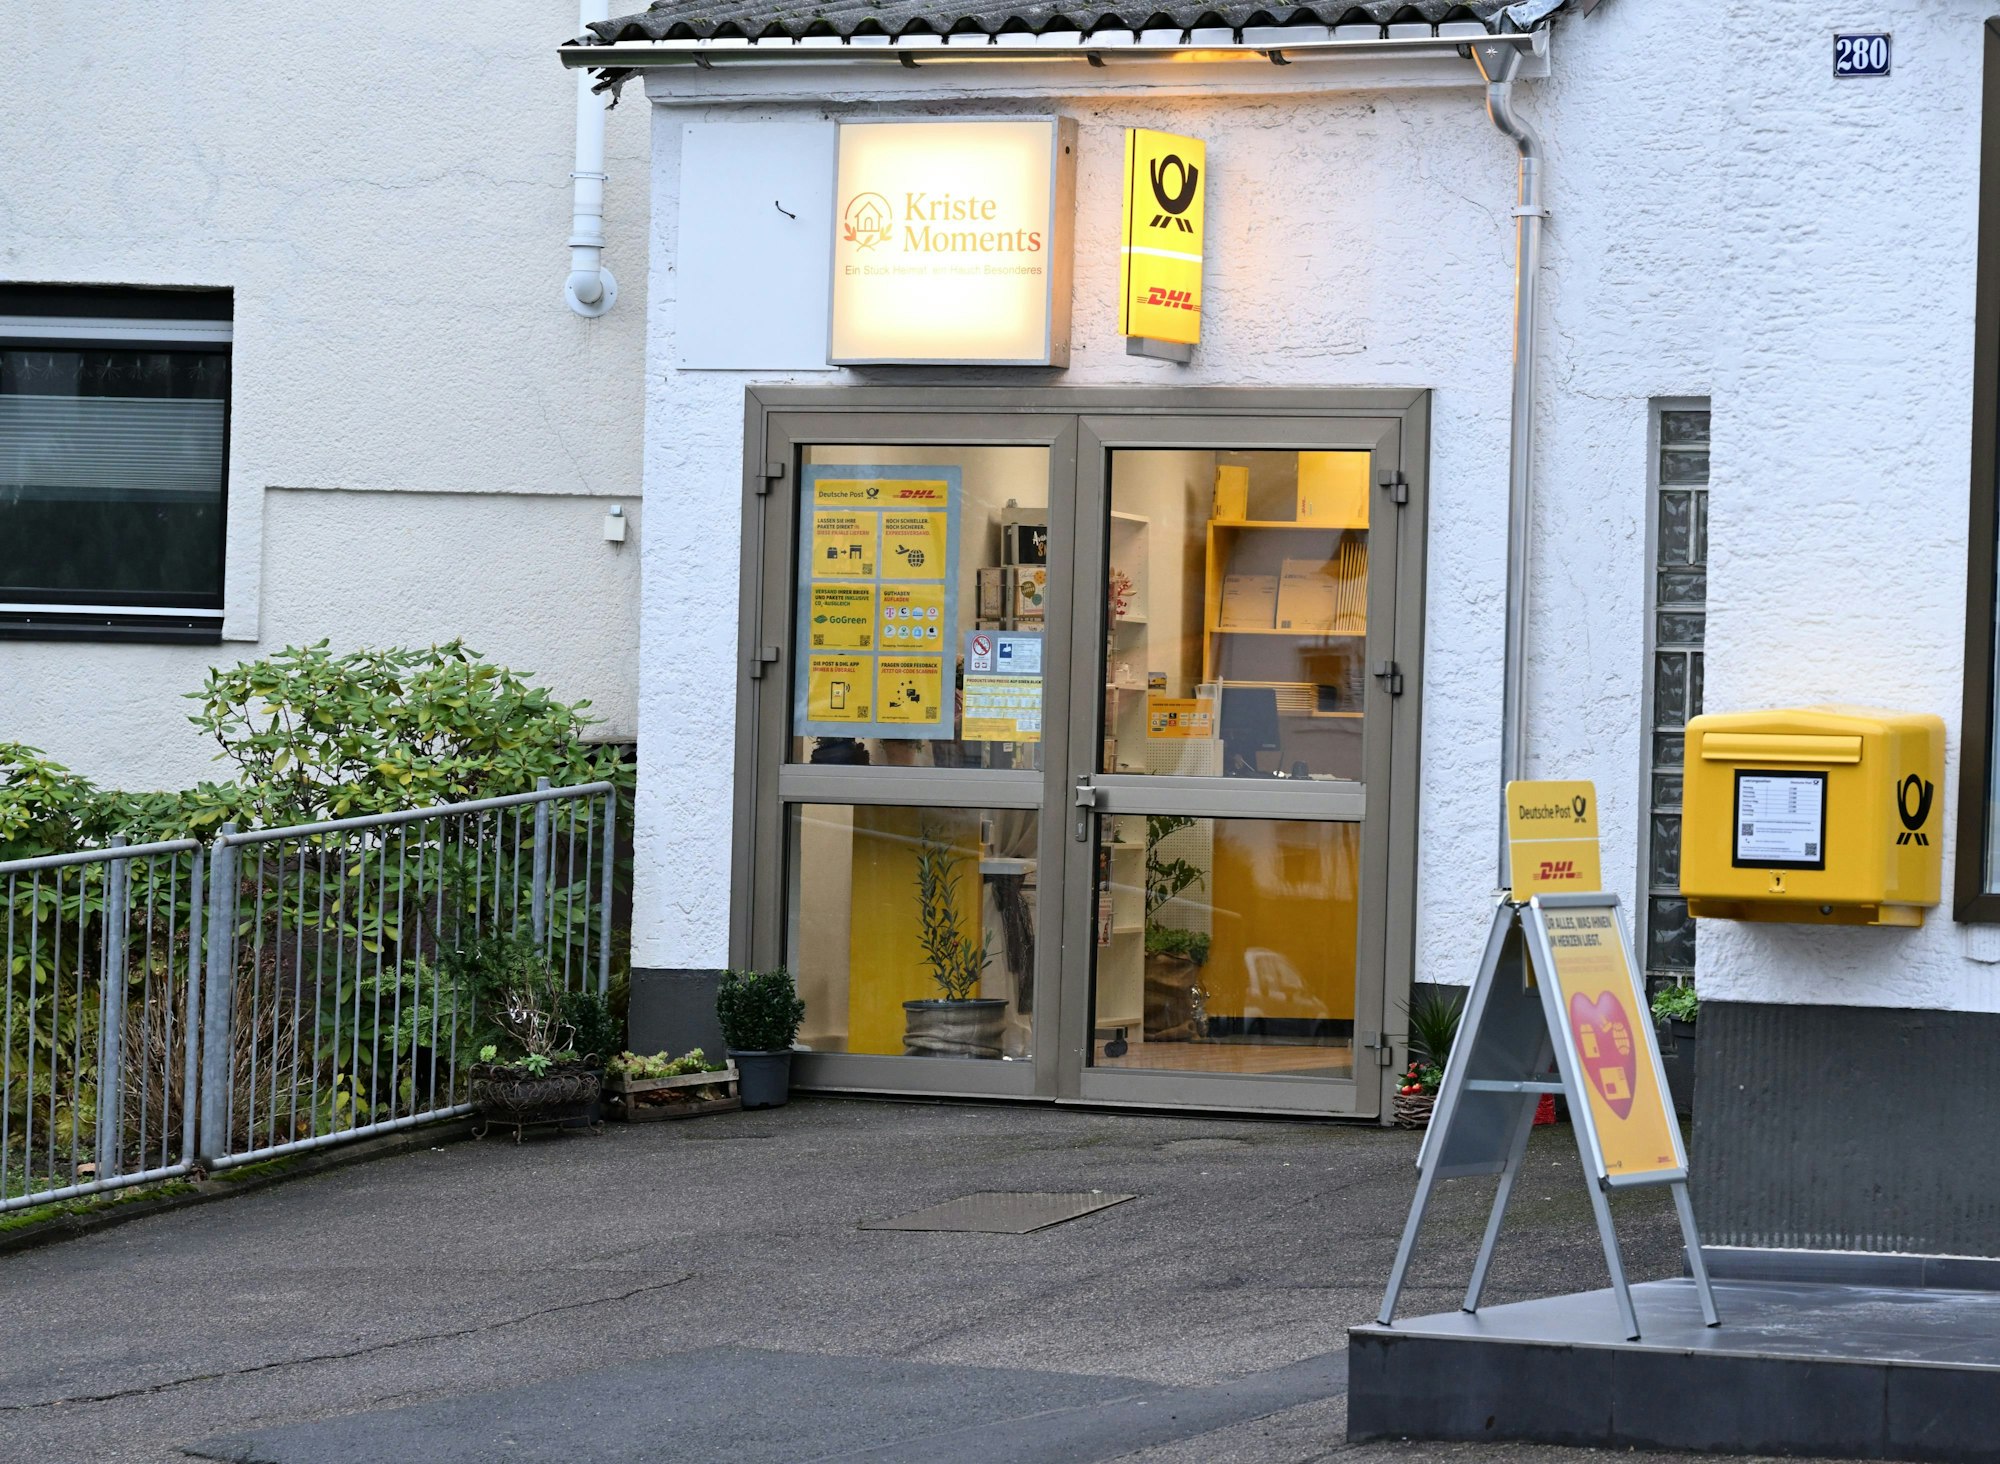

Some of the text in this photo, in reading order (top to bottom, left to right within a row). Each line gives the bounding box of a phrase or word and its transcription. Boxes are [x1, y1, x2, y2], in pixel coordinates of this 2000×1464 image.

[1836, 37, 1888, 71] 280
[904, 192, 997, 222] Kriste
[903, 225, 1042, 253] Moments
[845, 265, 861, 276] Ein
[983, 264, 1043, 276] Besonderes
[1146, 286, 1195, 311] DHL
[818, 491, 864, 499] Deutsche Post
[899, 489, 937, 499] DHL
[829, 615, 867, 625] GoGreen
[1518, 804, 1572, 821] Deutsche Post
[1539, 860, 1577, 880] DHL
[1555, 916, 1578, 931] ALLES,
[1576, 916, 1593, 929] WAS
[1591, 916, 1612, 929] IHNEN
[1556, 934, 1583, 947] HERZEN
